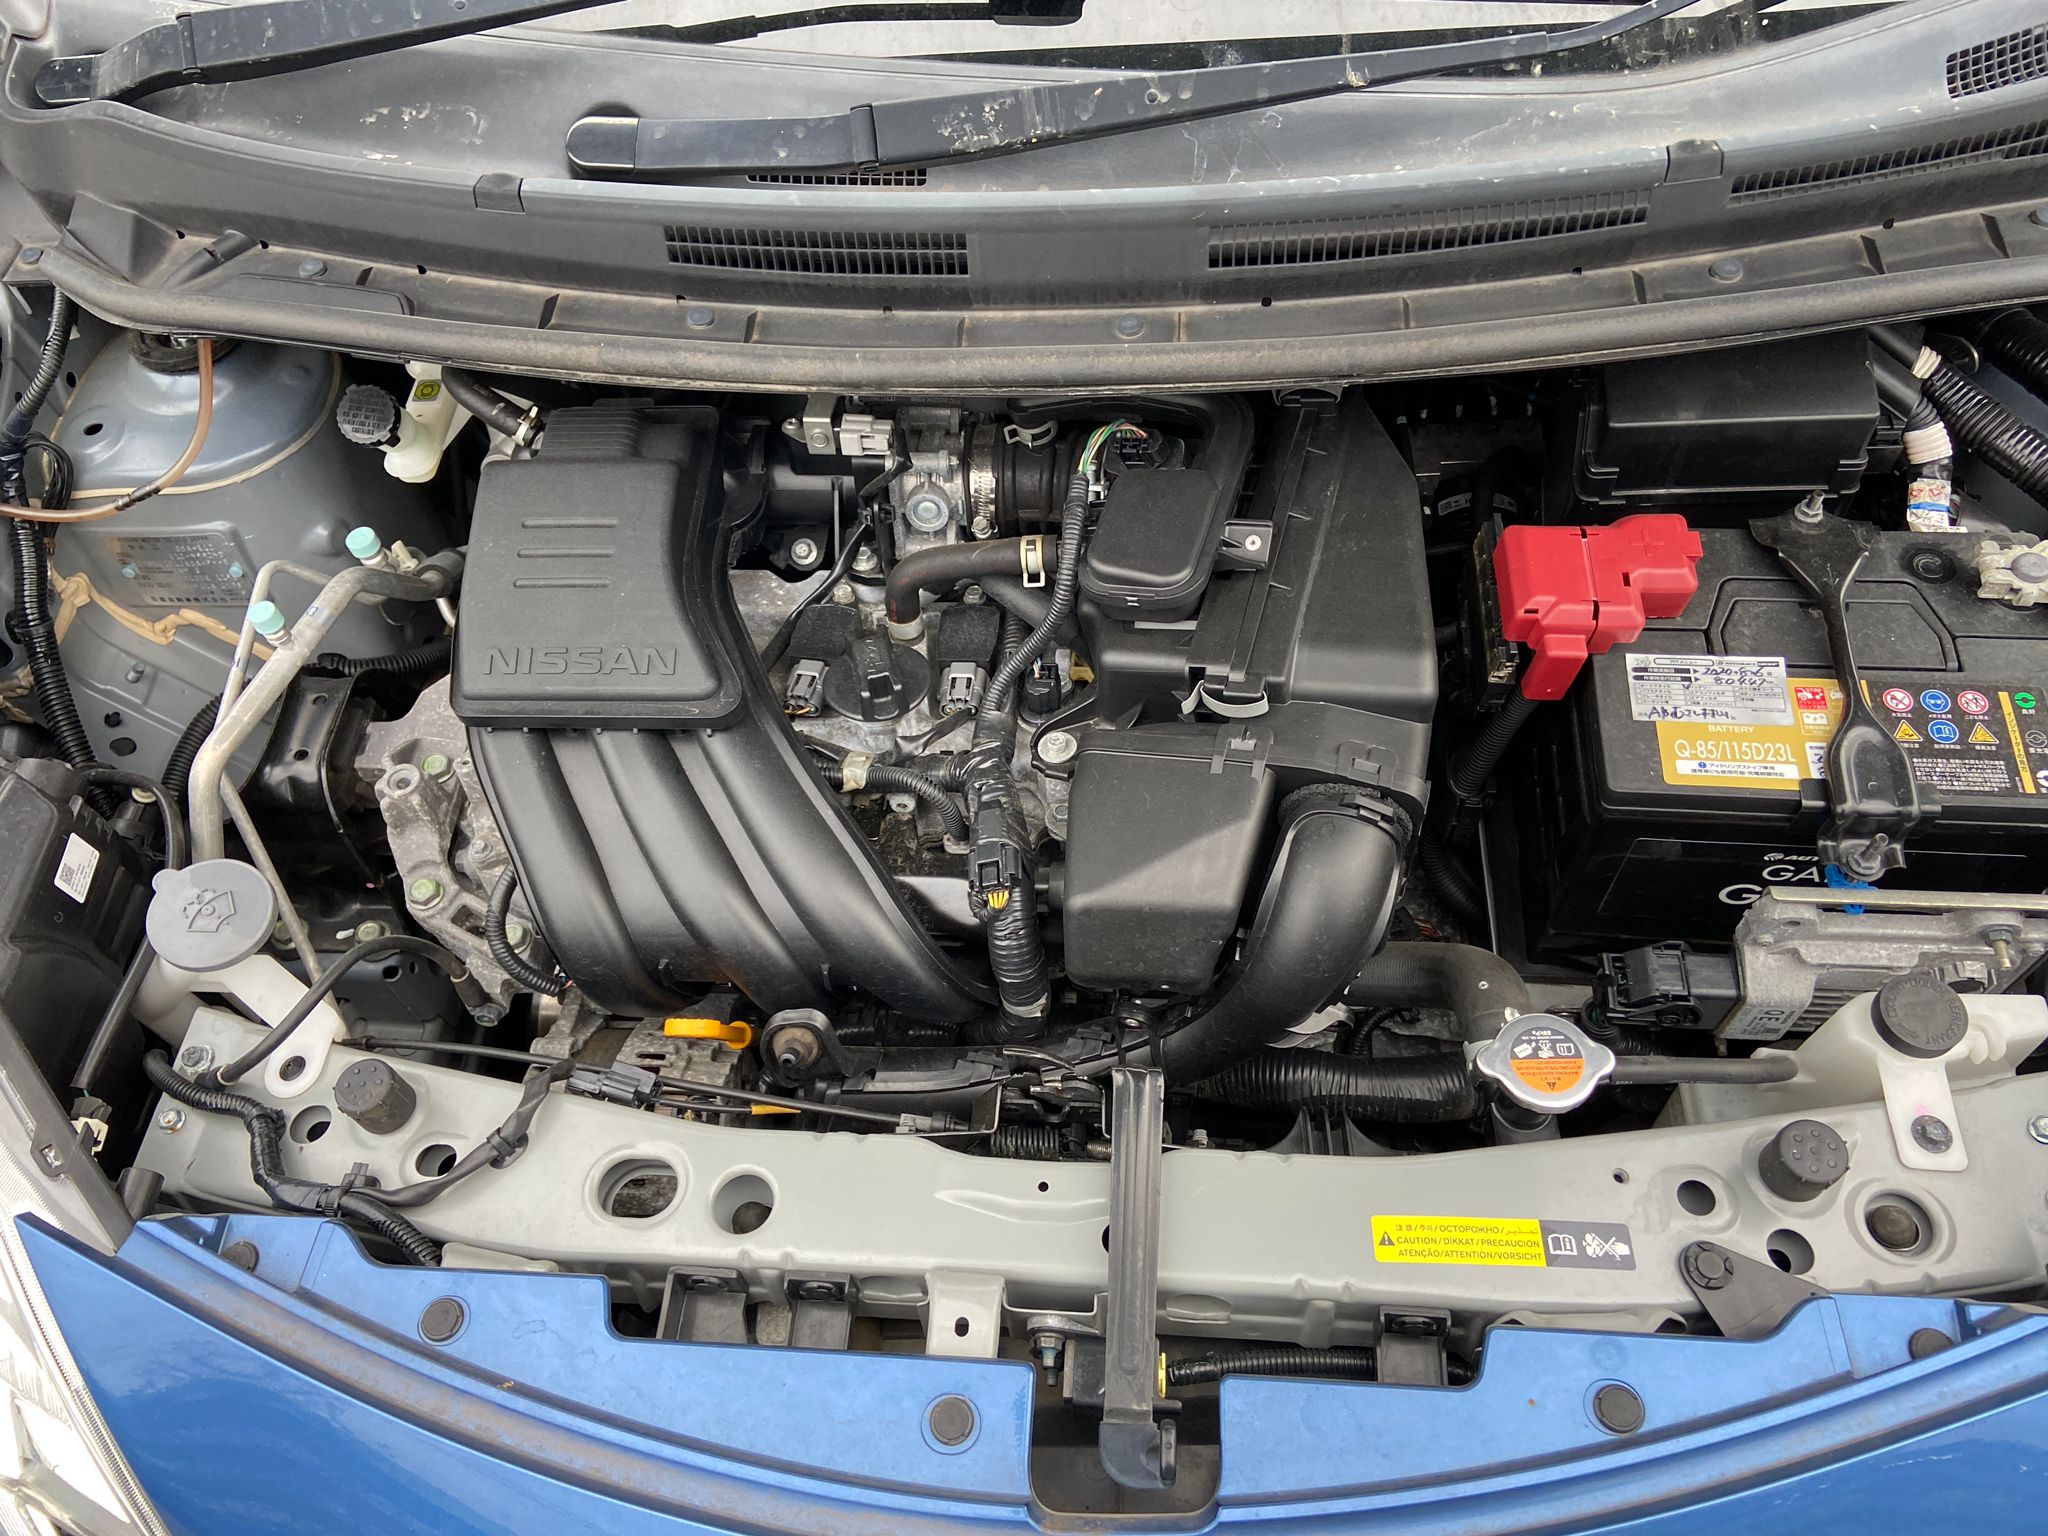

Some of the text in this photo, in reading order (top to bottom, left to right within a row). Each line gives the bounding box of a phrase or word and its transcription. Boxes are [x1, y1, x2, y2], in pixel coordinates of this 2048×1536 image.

[483, 646, 677, 675] NISSAN
[1708, 725, 1754, 734] BATTERY
[1674, 739, 1796, 762] Q-85/115D23L
[1396, 1236, 1437, 1245] CAUTION
